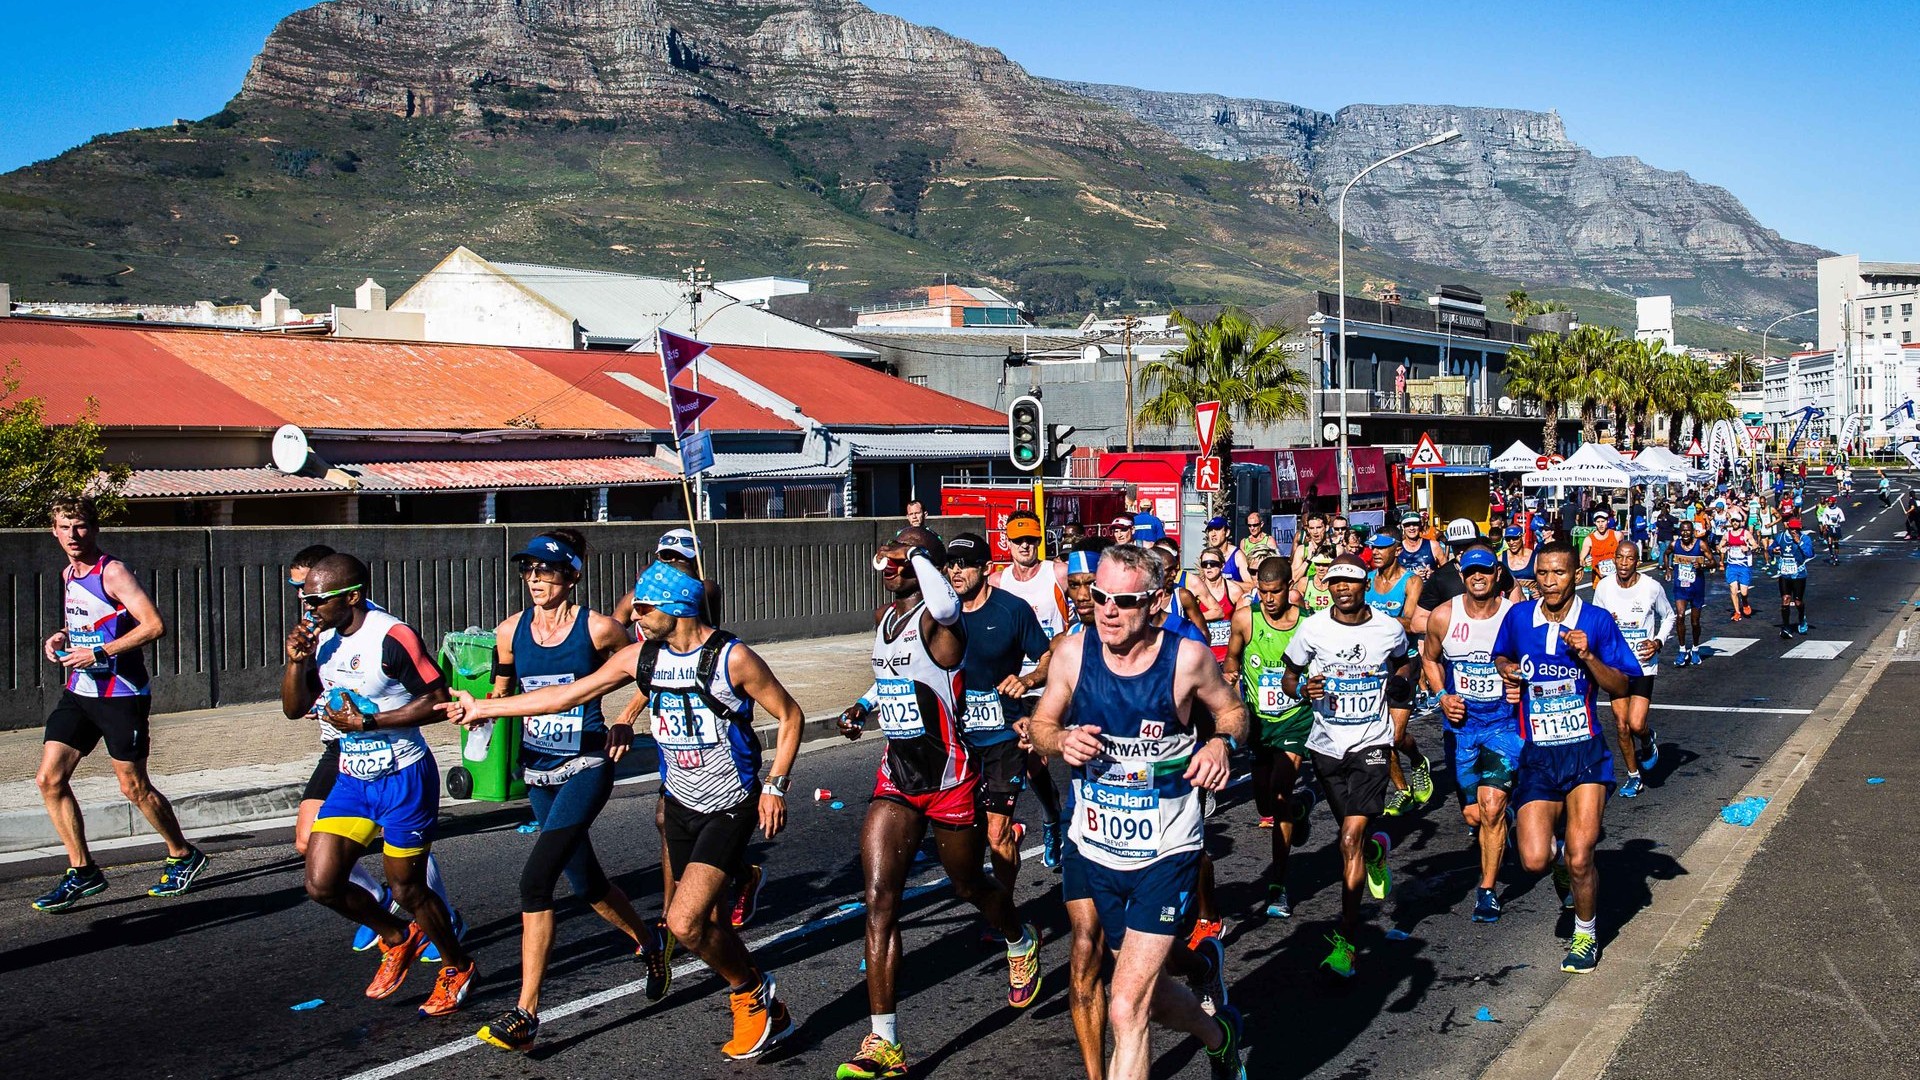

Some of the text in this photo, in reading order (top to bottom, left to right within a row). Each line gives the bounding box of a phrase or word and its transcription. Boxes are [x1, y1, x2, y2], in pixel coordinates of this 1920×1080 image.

[667, 349, 679, 361] 3:15
[676, 399, 700, 414] Youssef
[1300, 467, 1314, 478] drink
[1357, 464, 1376, 474] ice cold
[1578, 463, 1613, 471] TIMES
[1272, 526, 1294, 545] TIMES
[1449, 525, 1471, 537] KAUAI
[1315, 596, 1329, 606] 55
[71, 633, 101, 643] Sanlam
[903, 635, 918, 643] sport
[1451, 622, 1470, 643] 40
[1474, 654, 1488, 662] AAC
[651, 666, 676, 681] entral
[878, 682, 912, 696] Sanlam
[1338, 680, 1378, 692] Sanlam
[1460, 676, 1495, 693] B833
[1329, 695, 1377, 713] B1107
[1543, 698, 1583, 713] Sanlam
[526, 716, 575, 744] C3481
[1141, 723, 1163, 739] 40
[1531, 712, 1589, 736] F11402
[345, 740, 387, 752] Sanlam
[1096, 788, 1154, 809] Sanlam
[1086, 806, 1153, 840] B1090
[1103, 838, 1129, 848] TREVOR
